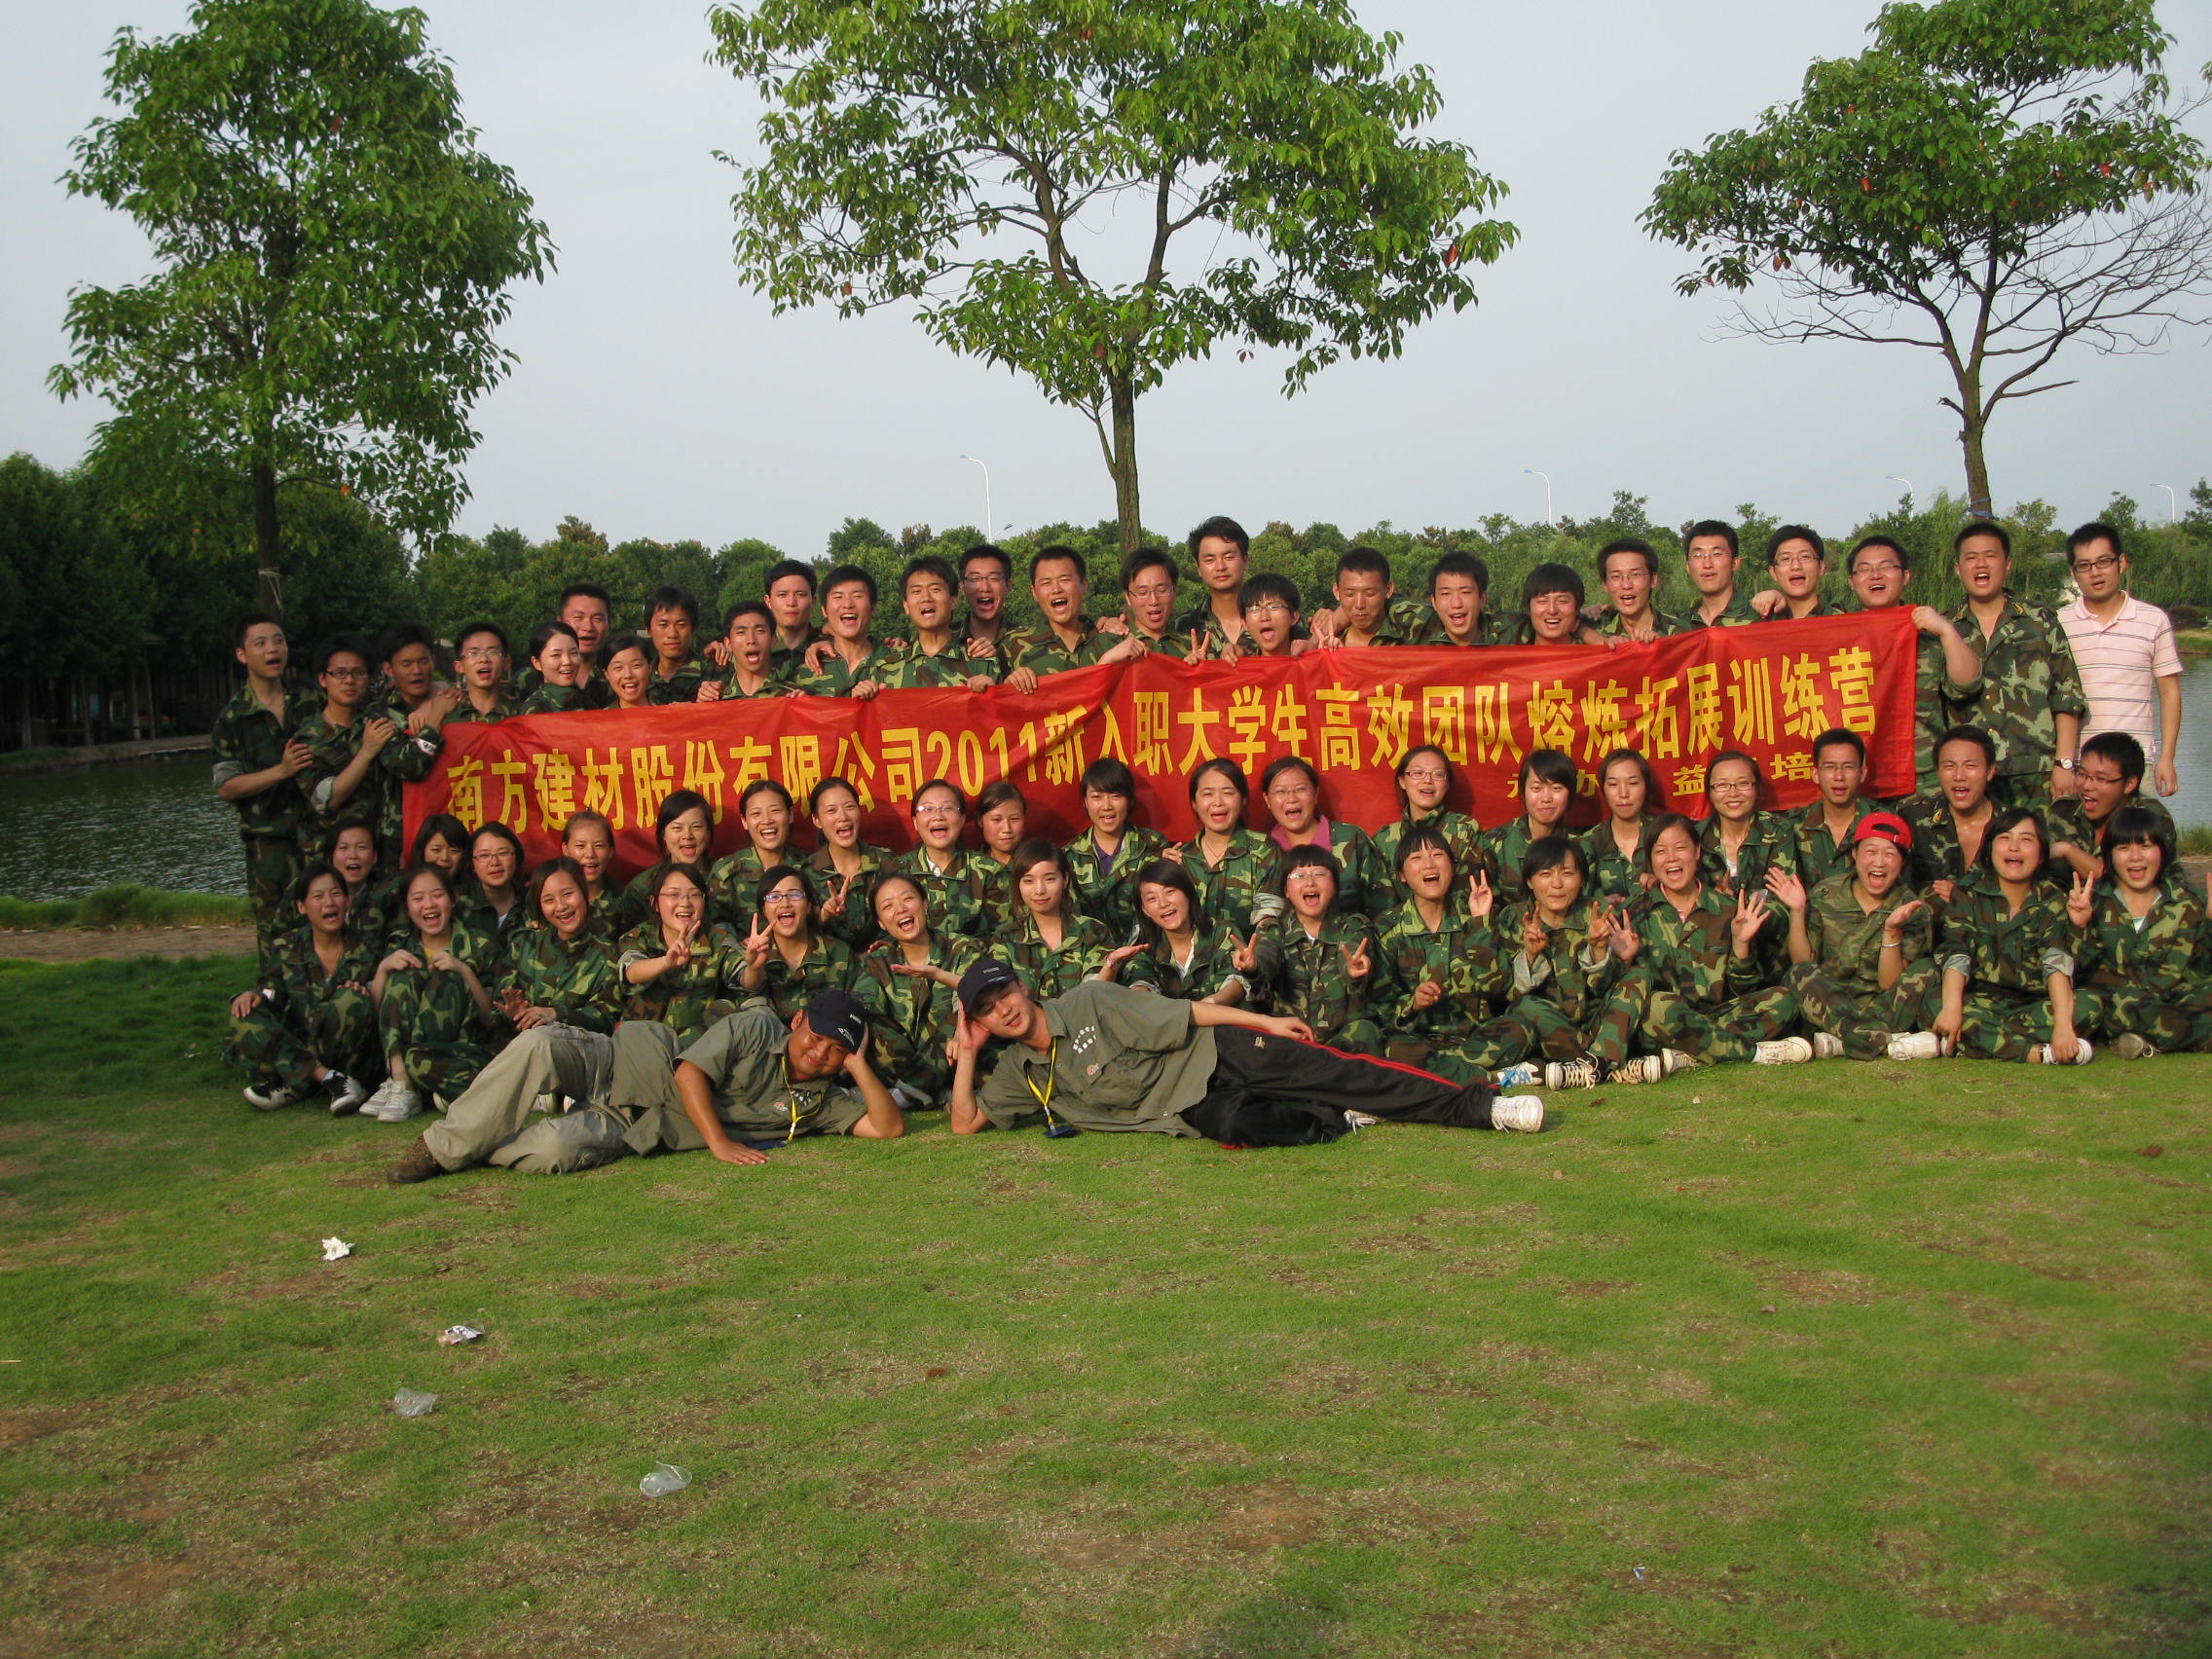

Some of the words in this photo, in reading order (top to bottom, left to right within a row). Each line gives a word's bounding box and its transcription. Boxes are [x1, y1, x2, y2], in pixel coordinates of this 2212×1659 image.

[447, 646, 1876, 834] 南方建材股份有限公司2011新入职大学生高效团队熔炼拓展训练营
